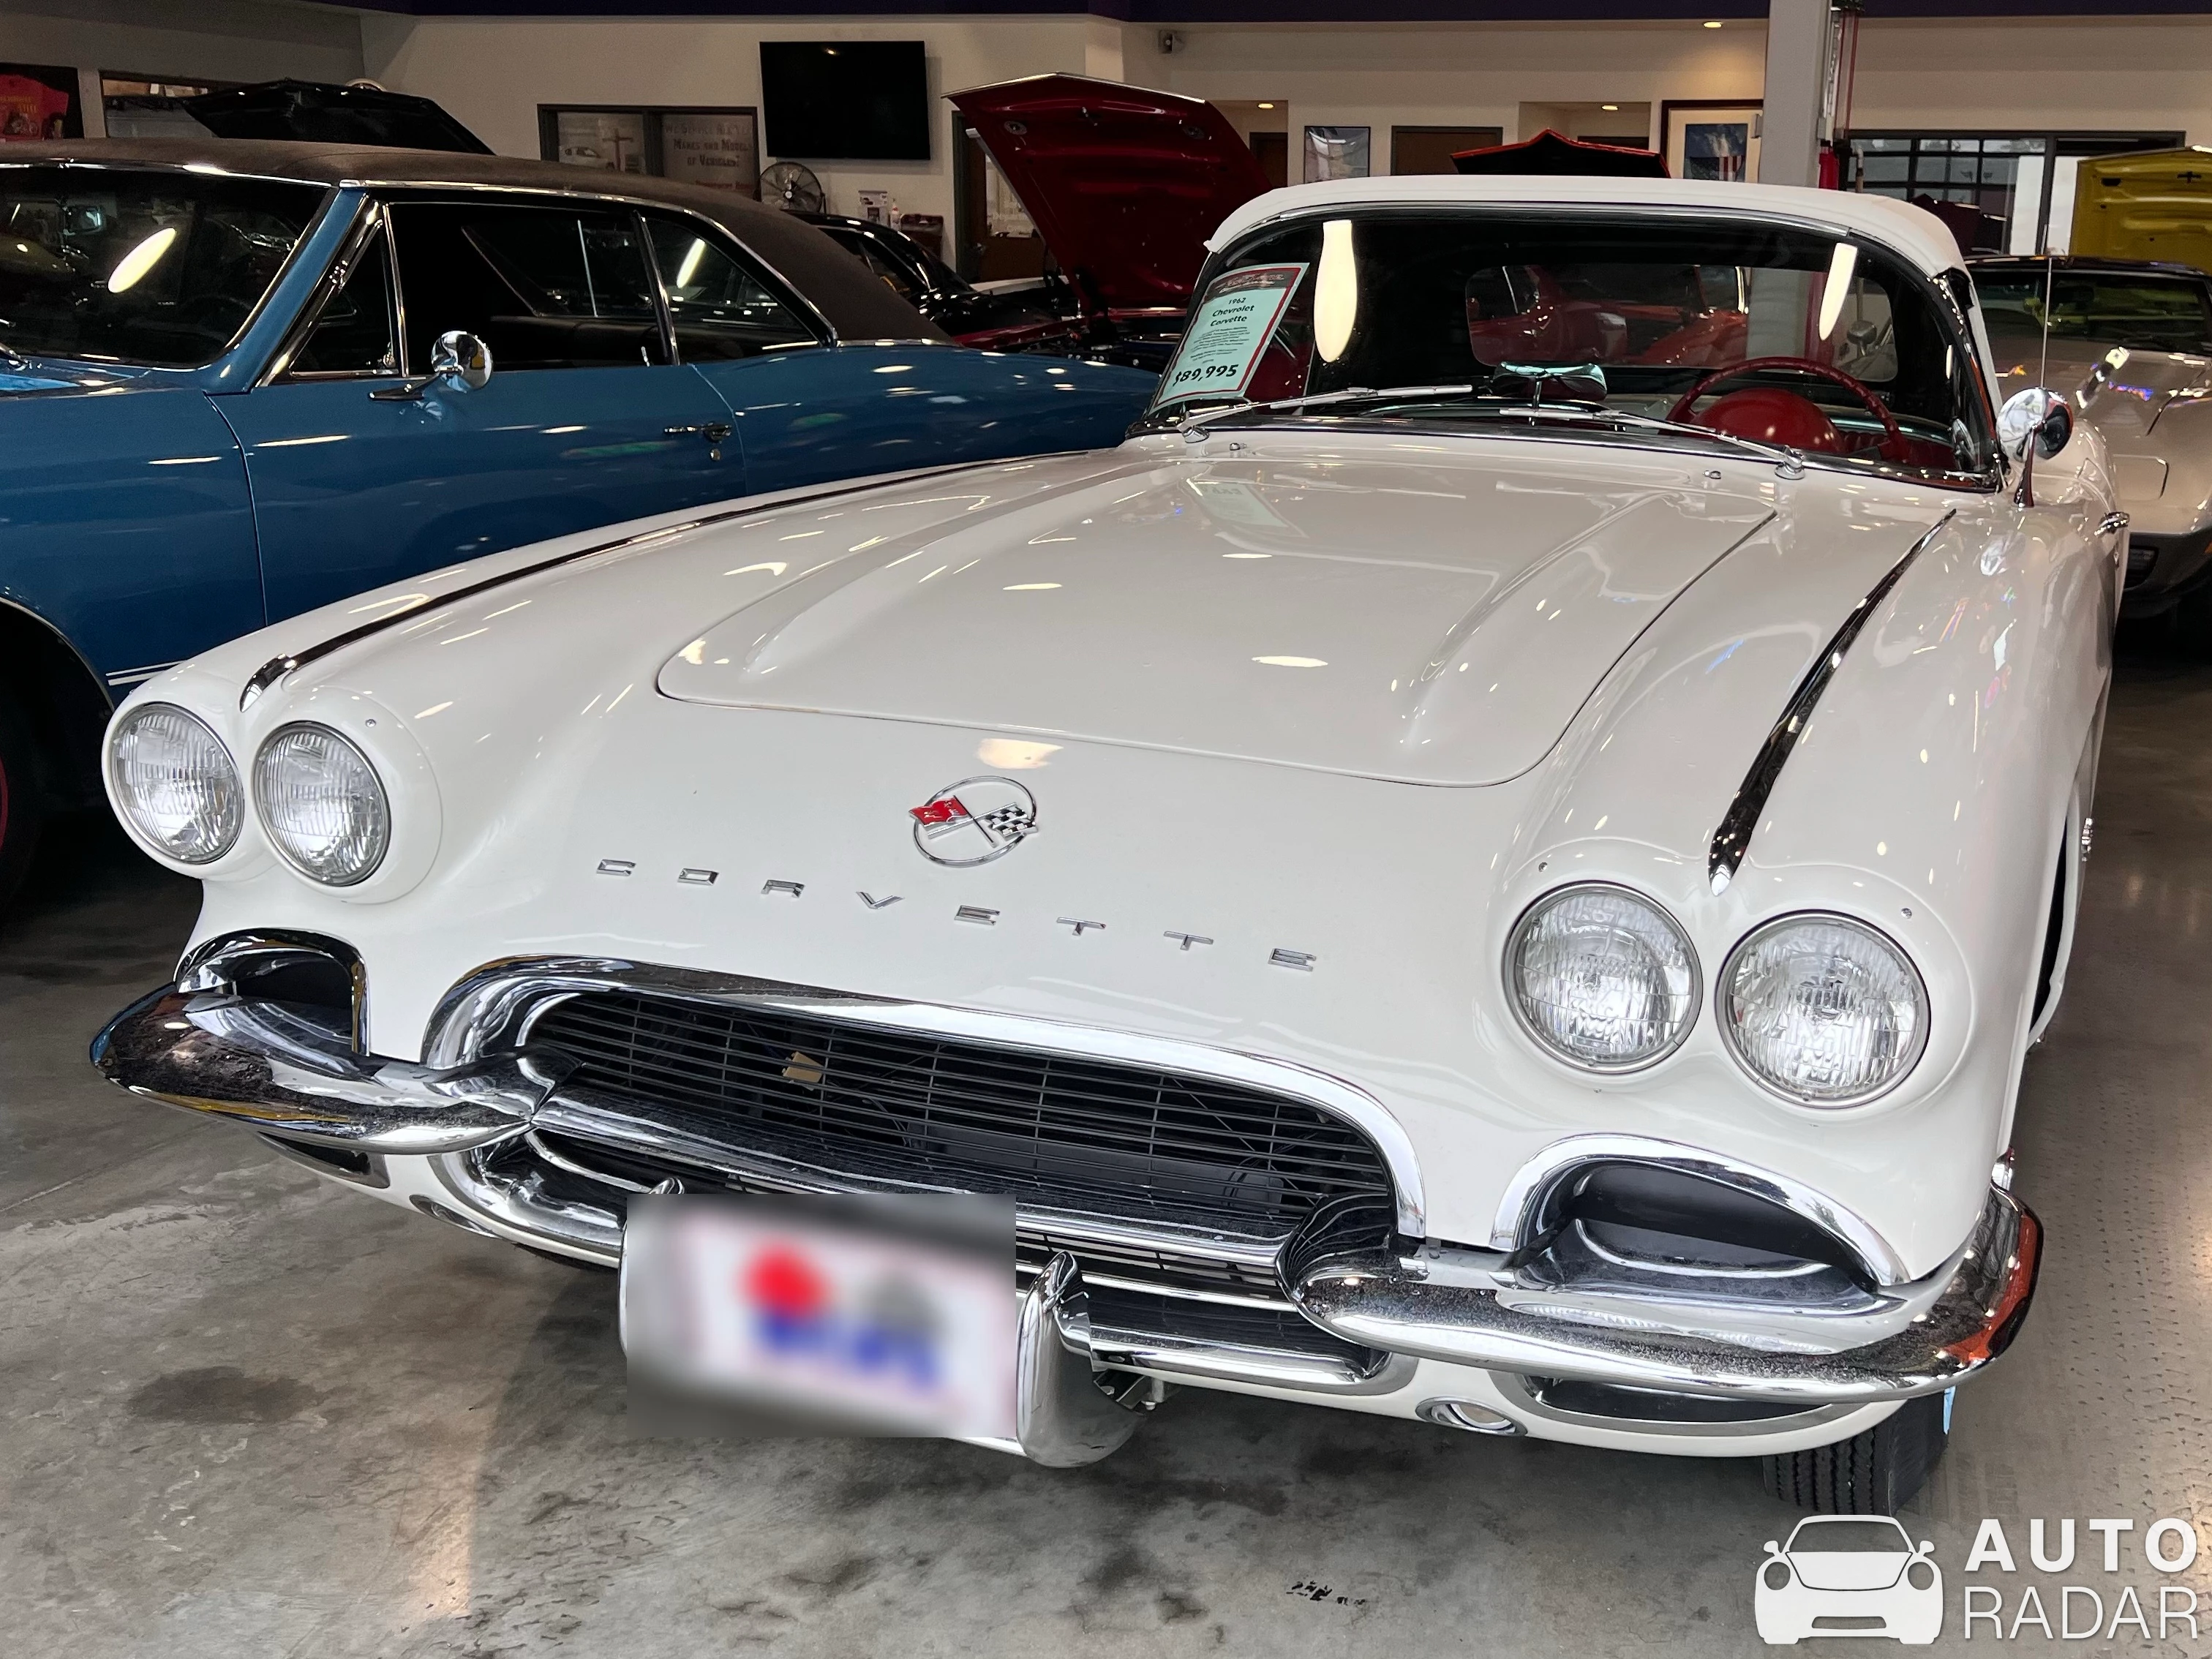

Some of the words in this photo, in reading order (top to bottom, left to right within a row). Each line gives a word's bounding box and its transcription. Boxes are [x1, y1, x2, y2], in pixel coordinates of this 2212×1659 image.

[1228, 297, 1246, 305] 1962
[1212, 305, 1254, 317] Chevrolet
[1210, 315, 1247, 327] Corvette
[1172, 364, 1239, 387] $89,995
[595, 858, 1317, 972] CORVETTE
